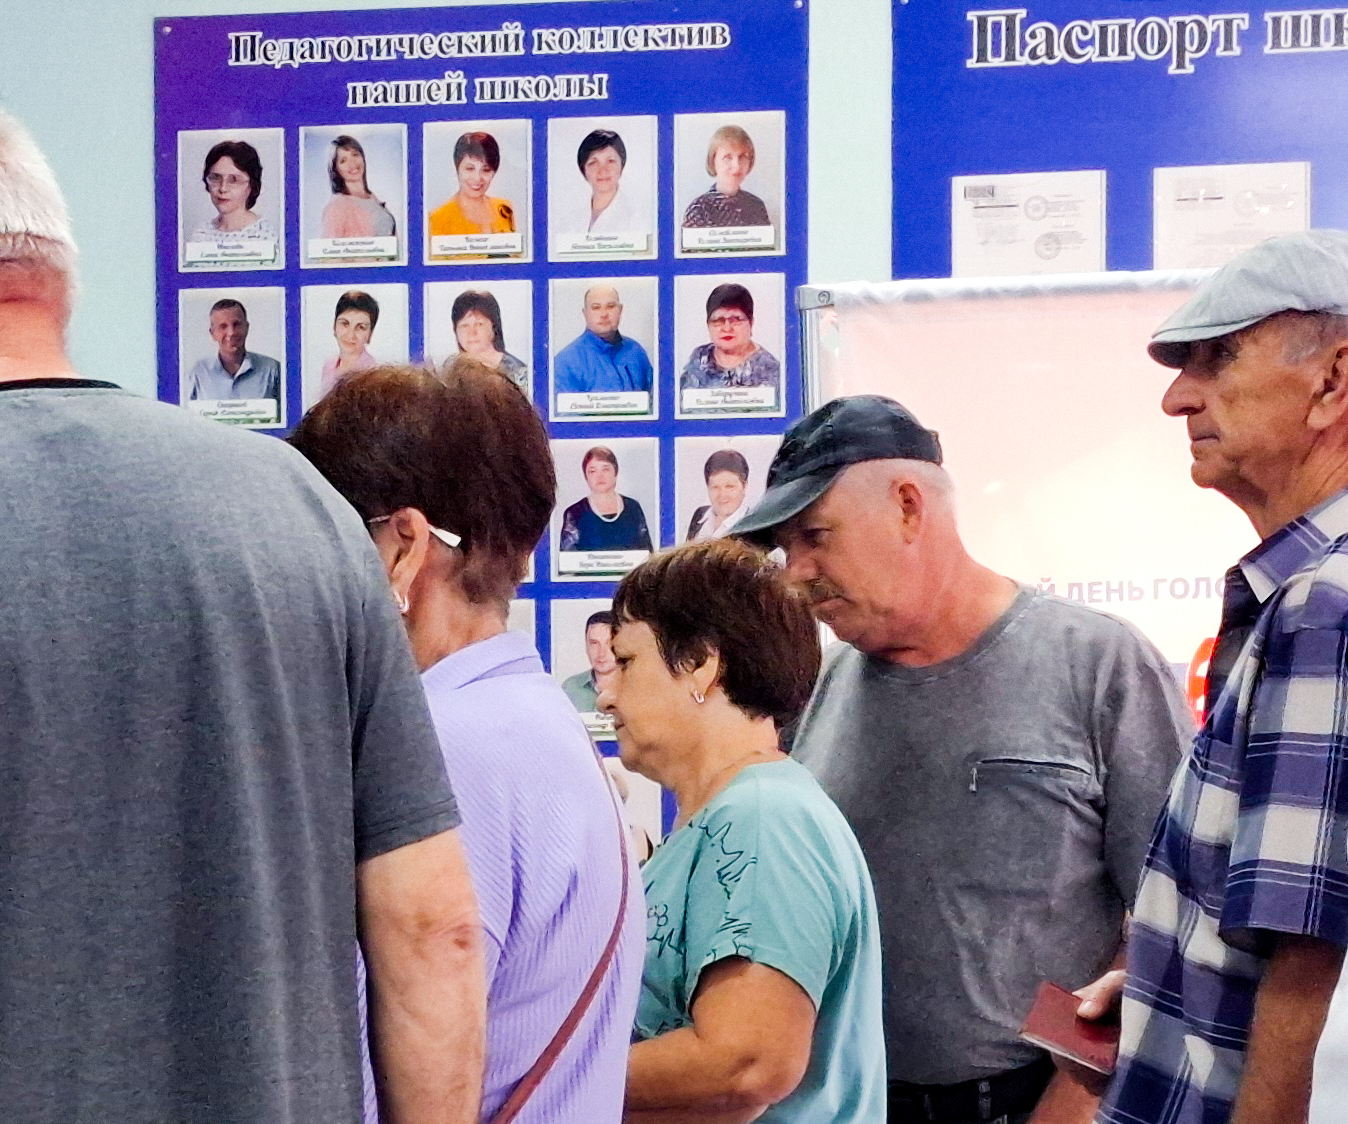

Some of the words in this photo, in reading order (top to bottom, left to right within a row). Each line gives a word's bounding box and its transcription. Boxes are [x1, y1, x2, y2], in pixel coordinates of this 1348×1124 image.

[229, 23, 524, 68] Педагогический
[533, 21, 731, 54] коллектив
[966, 9, 1248, 75] Паспорт
[347, 71, 465, 107] нашей
[475, 72, 608, 102] школы
[1067, 579, 1145, 605] ДЕНЬ
